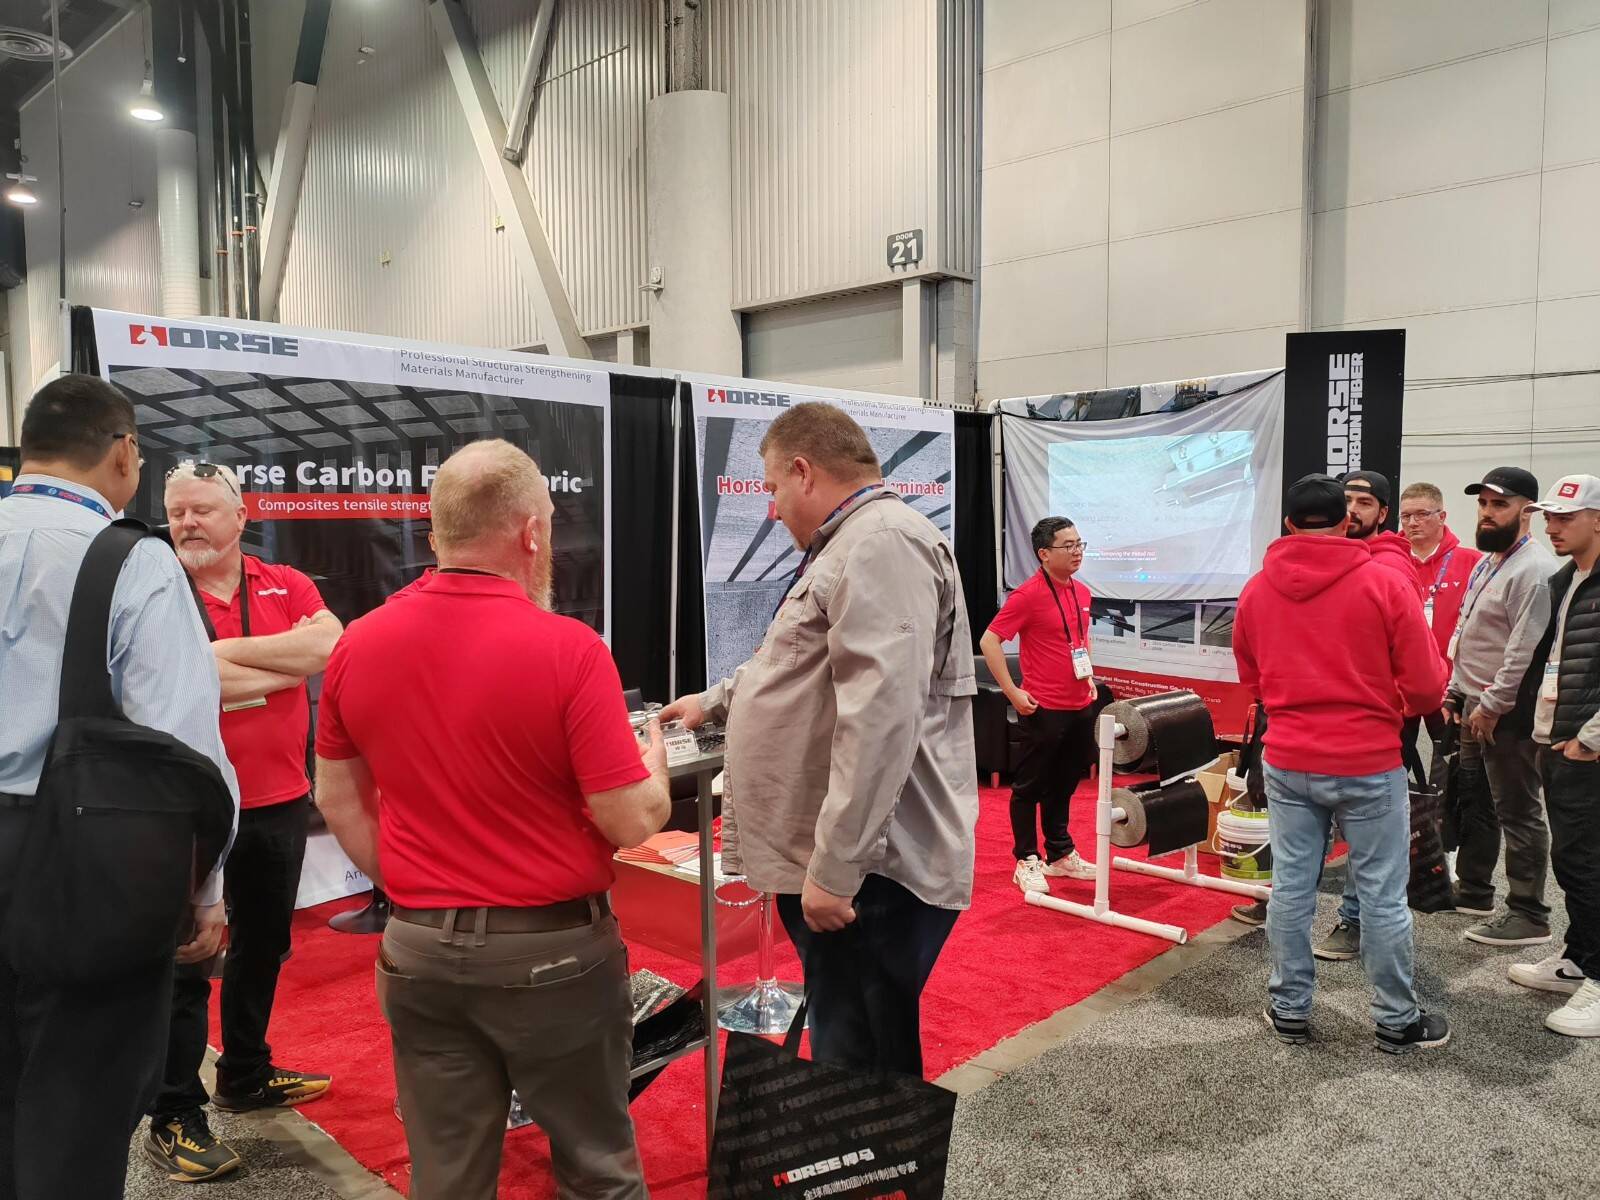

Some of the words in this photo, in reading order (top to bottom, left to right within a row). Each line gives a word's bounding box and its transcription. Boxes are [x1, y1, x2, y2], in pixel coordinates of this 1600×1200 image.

[896, 231, 914, 241] DOOR
[892, 238, 918, 264] 21
[129, 324, 299, 357] HORSE
[400, 349, 469, 366] Professional
[472, 359, 523, 373] Structural
[525, 365, 592, 383] Strengthening
[400, 362, 453, 377] Materials
[455, 370, 525, 385] Manufacturer
[1349, 352, 1364, 412] FIBER
[708, 389, 791, 407] HORSE
[296, 461, 412, 487] Carbon
[258, 498, 339, 514] Composites
[343, 499, 387, 511] tensile
[390, 501, 432, 514] strengt
[773, 1157, 842, 1188] HORSE
